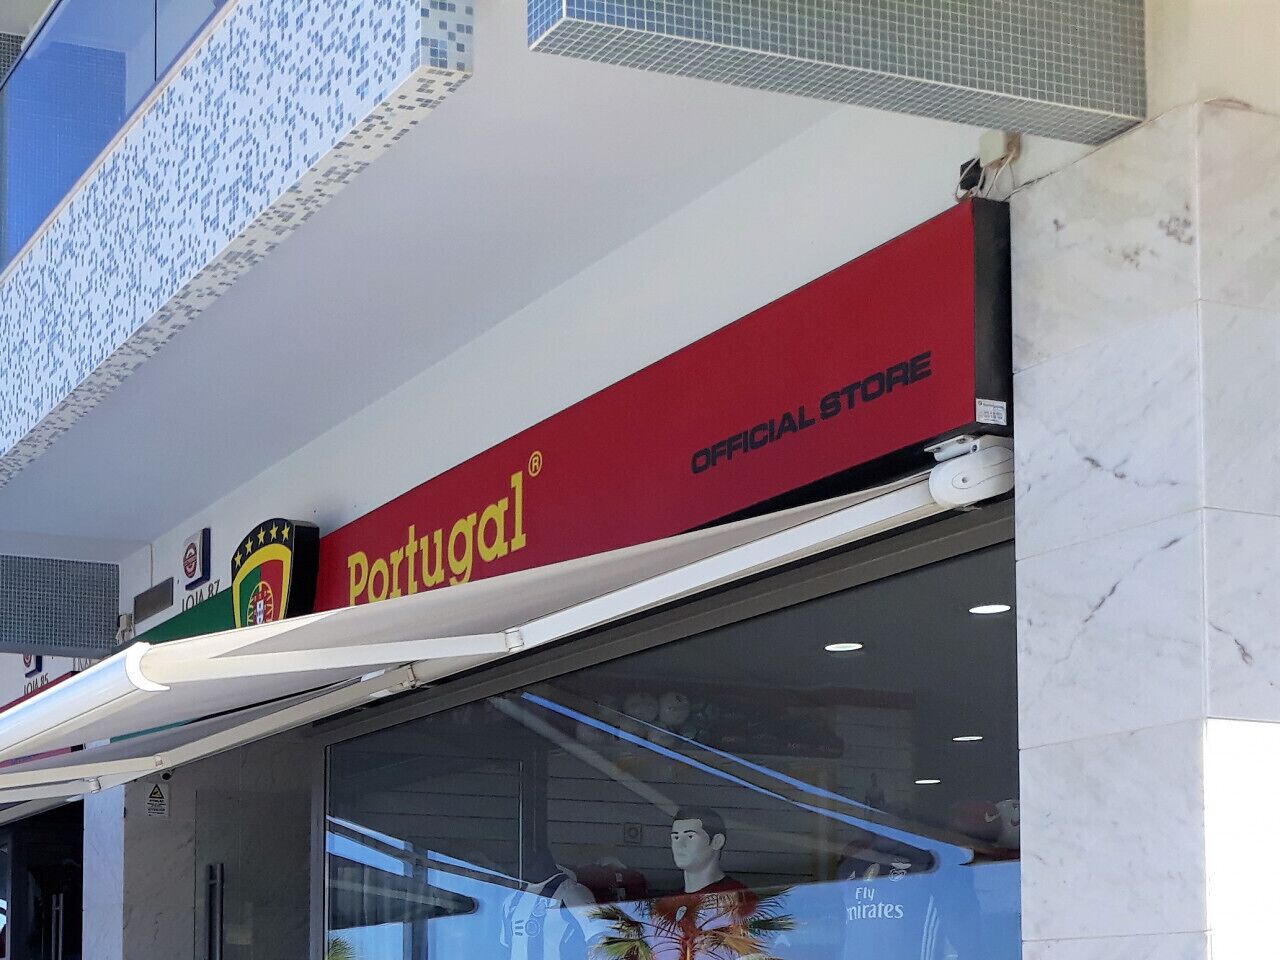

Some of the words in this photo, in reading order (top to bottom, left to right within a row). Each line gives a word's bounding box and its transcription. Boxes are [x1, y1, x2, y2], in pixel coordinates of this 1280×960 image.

[691, 406, 816, 474] OFFICIAL
[819, 351, 933, 421] STORE
[855, 886, 876, 902] Fly
